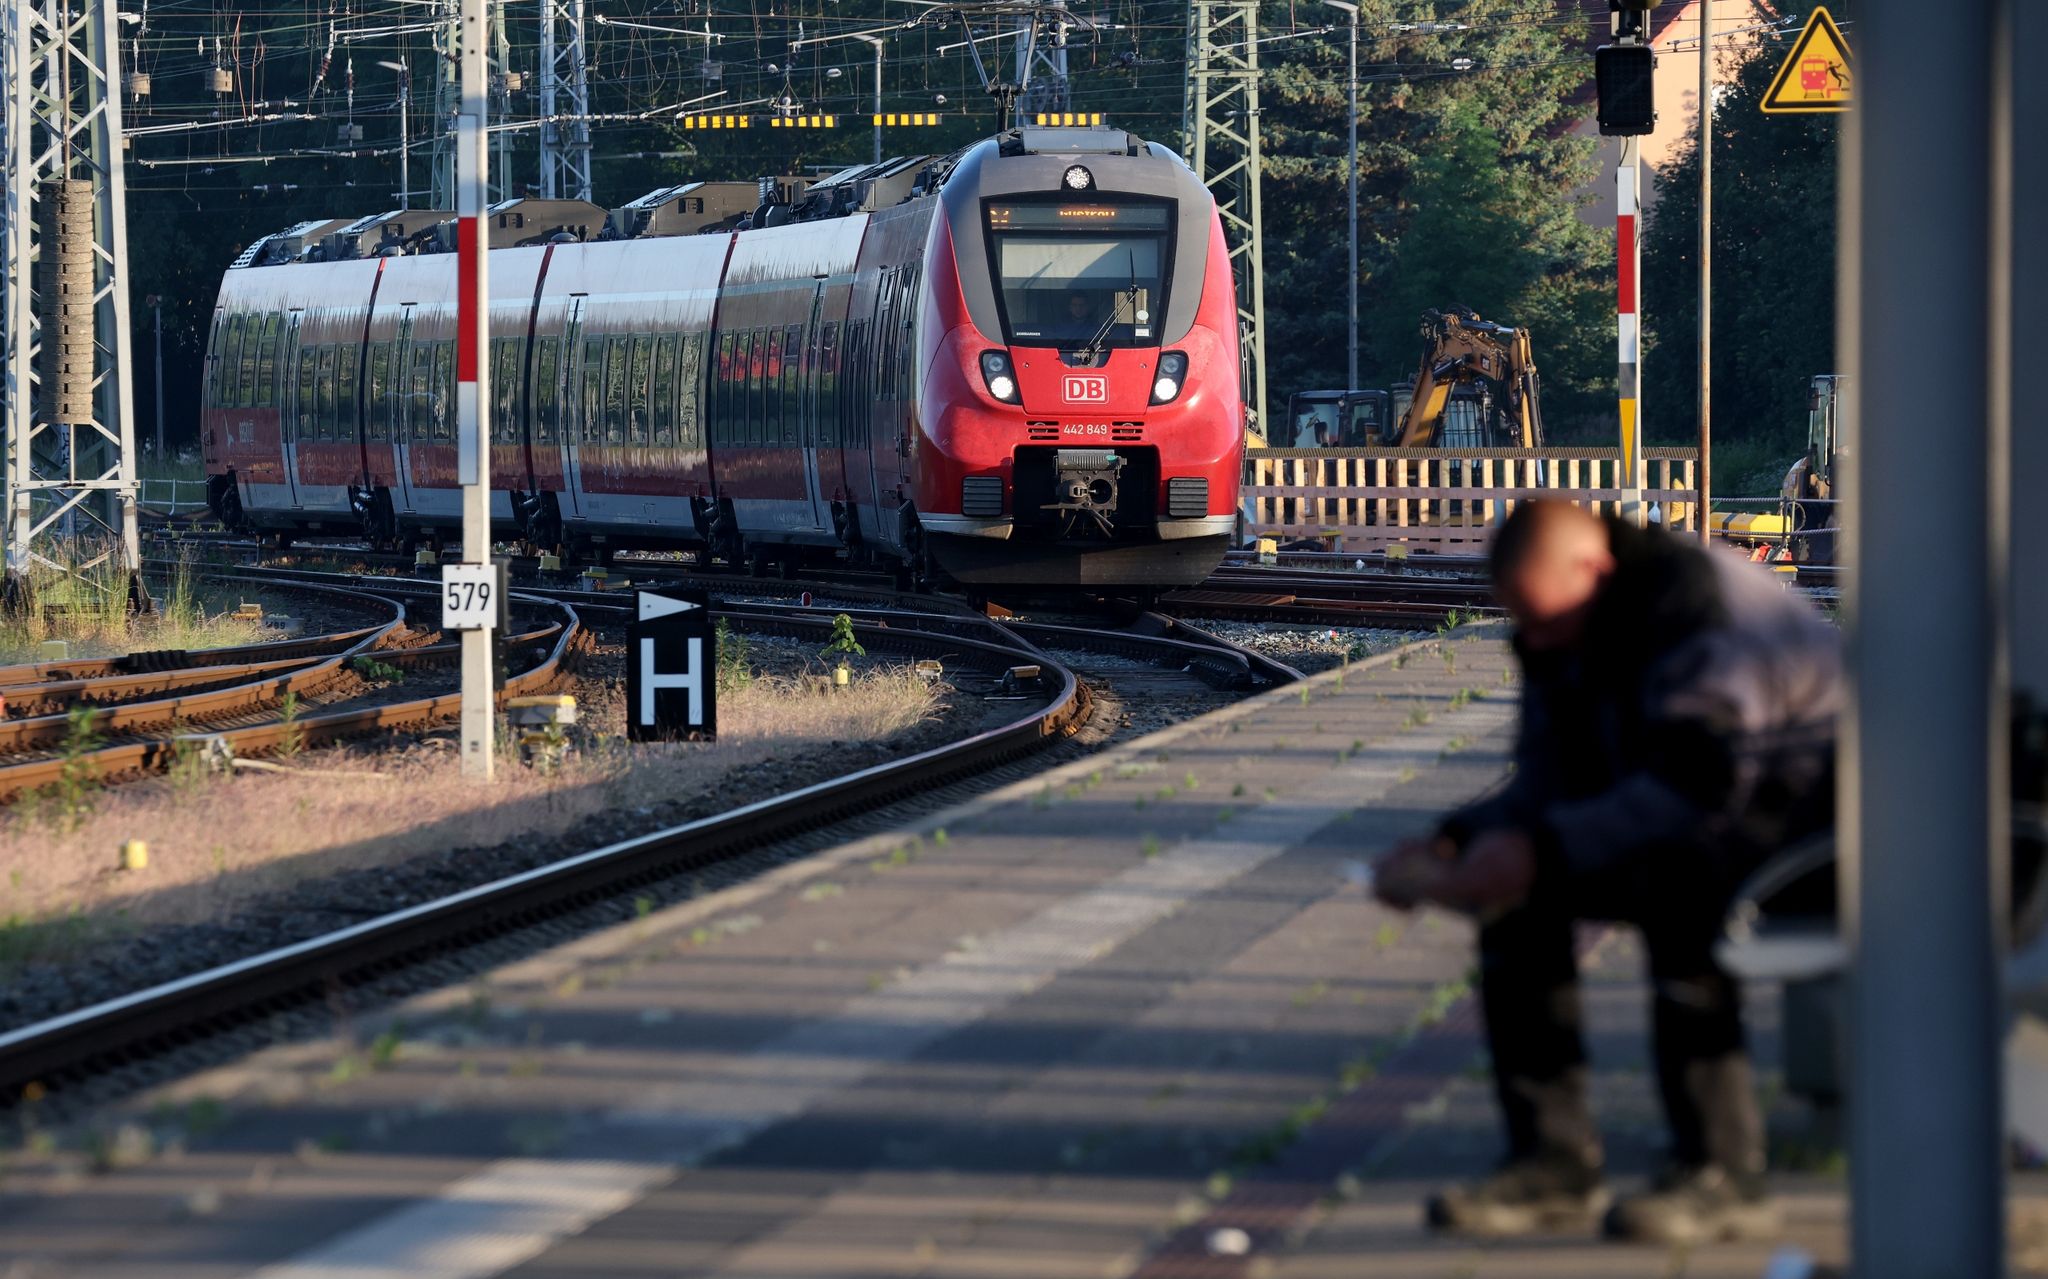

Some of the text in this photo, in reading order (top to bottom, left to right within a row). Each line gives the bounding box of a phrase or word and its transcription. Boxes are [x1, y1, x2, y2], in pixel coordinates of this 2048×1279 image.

[1067, 379, 1104, 400] DB
[1063, 424, 1108, 435] 442 849
[447, 581, 491, 612] 579
[640, 637, 703, 726] H
